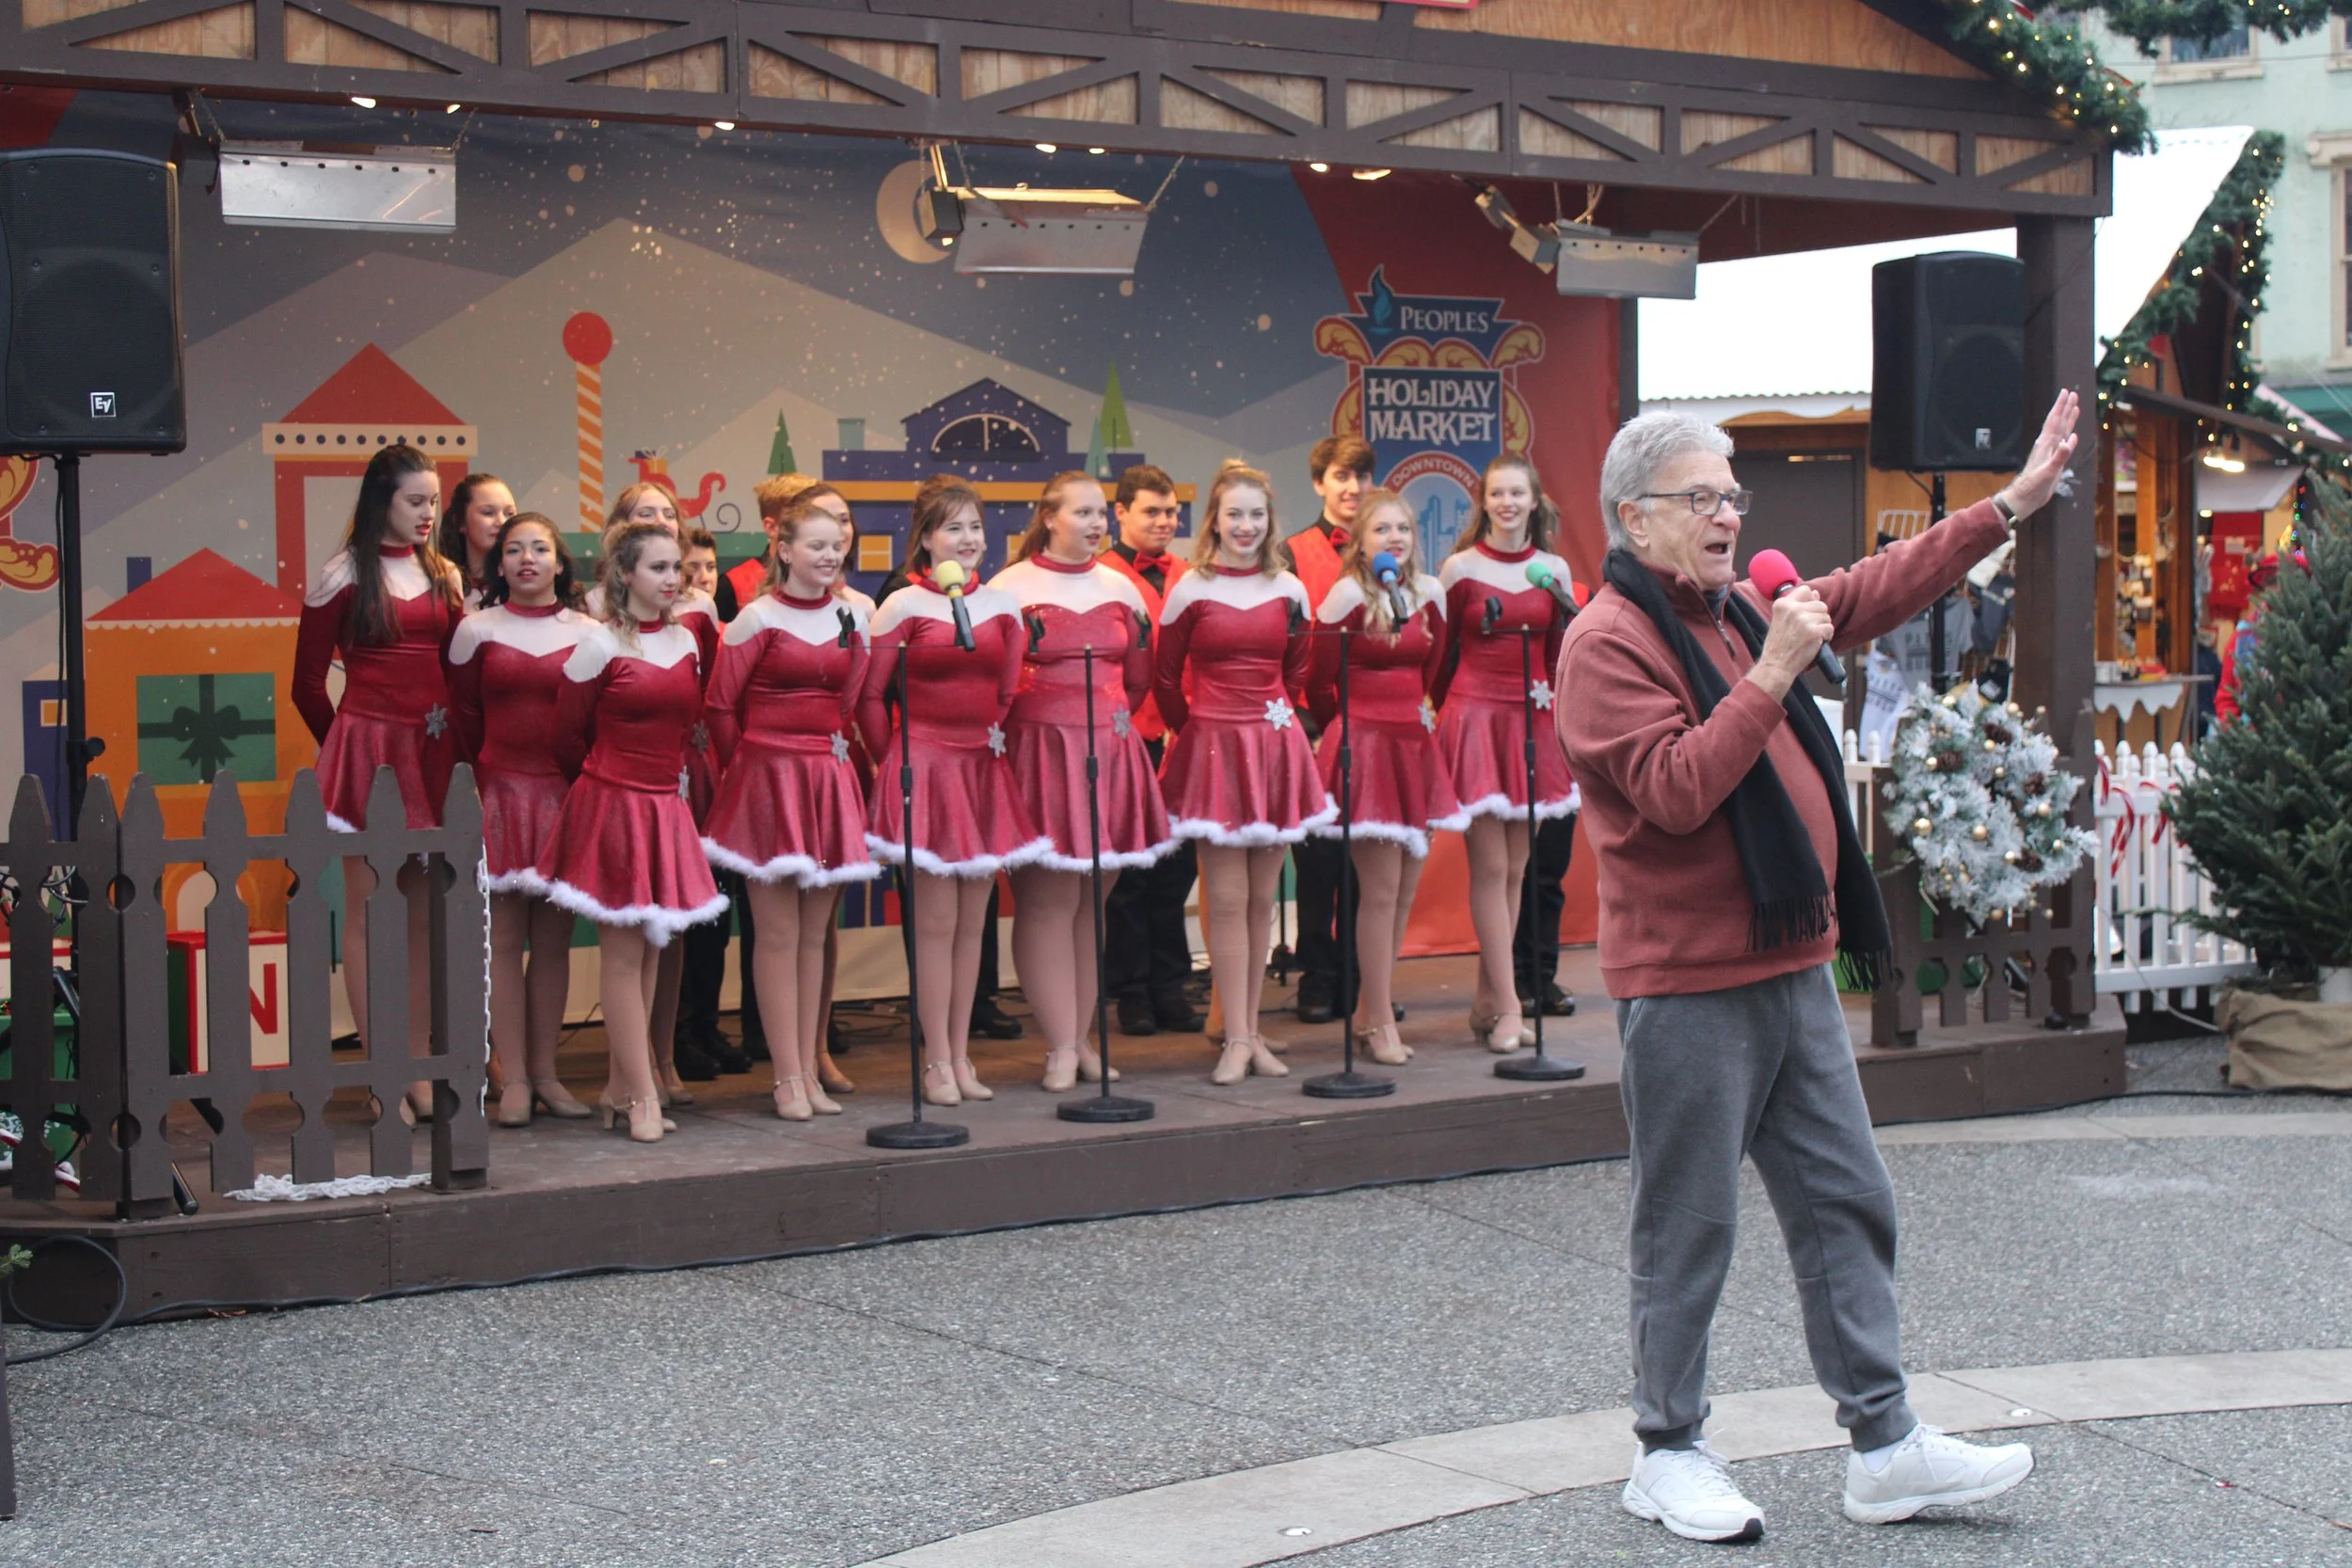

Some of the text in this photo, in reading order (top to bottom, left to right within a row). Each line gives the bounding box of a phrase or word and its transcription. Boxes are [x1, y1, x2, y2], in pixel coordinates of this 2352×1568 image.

[1401, 306, 1488, 332] PEOPLES
[1368, 378, 1495, 408] HOLIDAY
[1370, 412, 1496, 446] MARKET
[1392, 458, 1475, 487] DOWNTOWN
